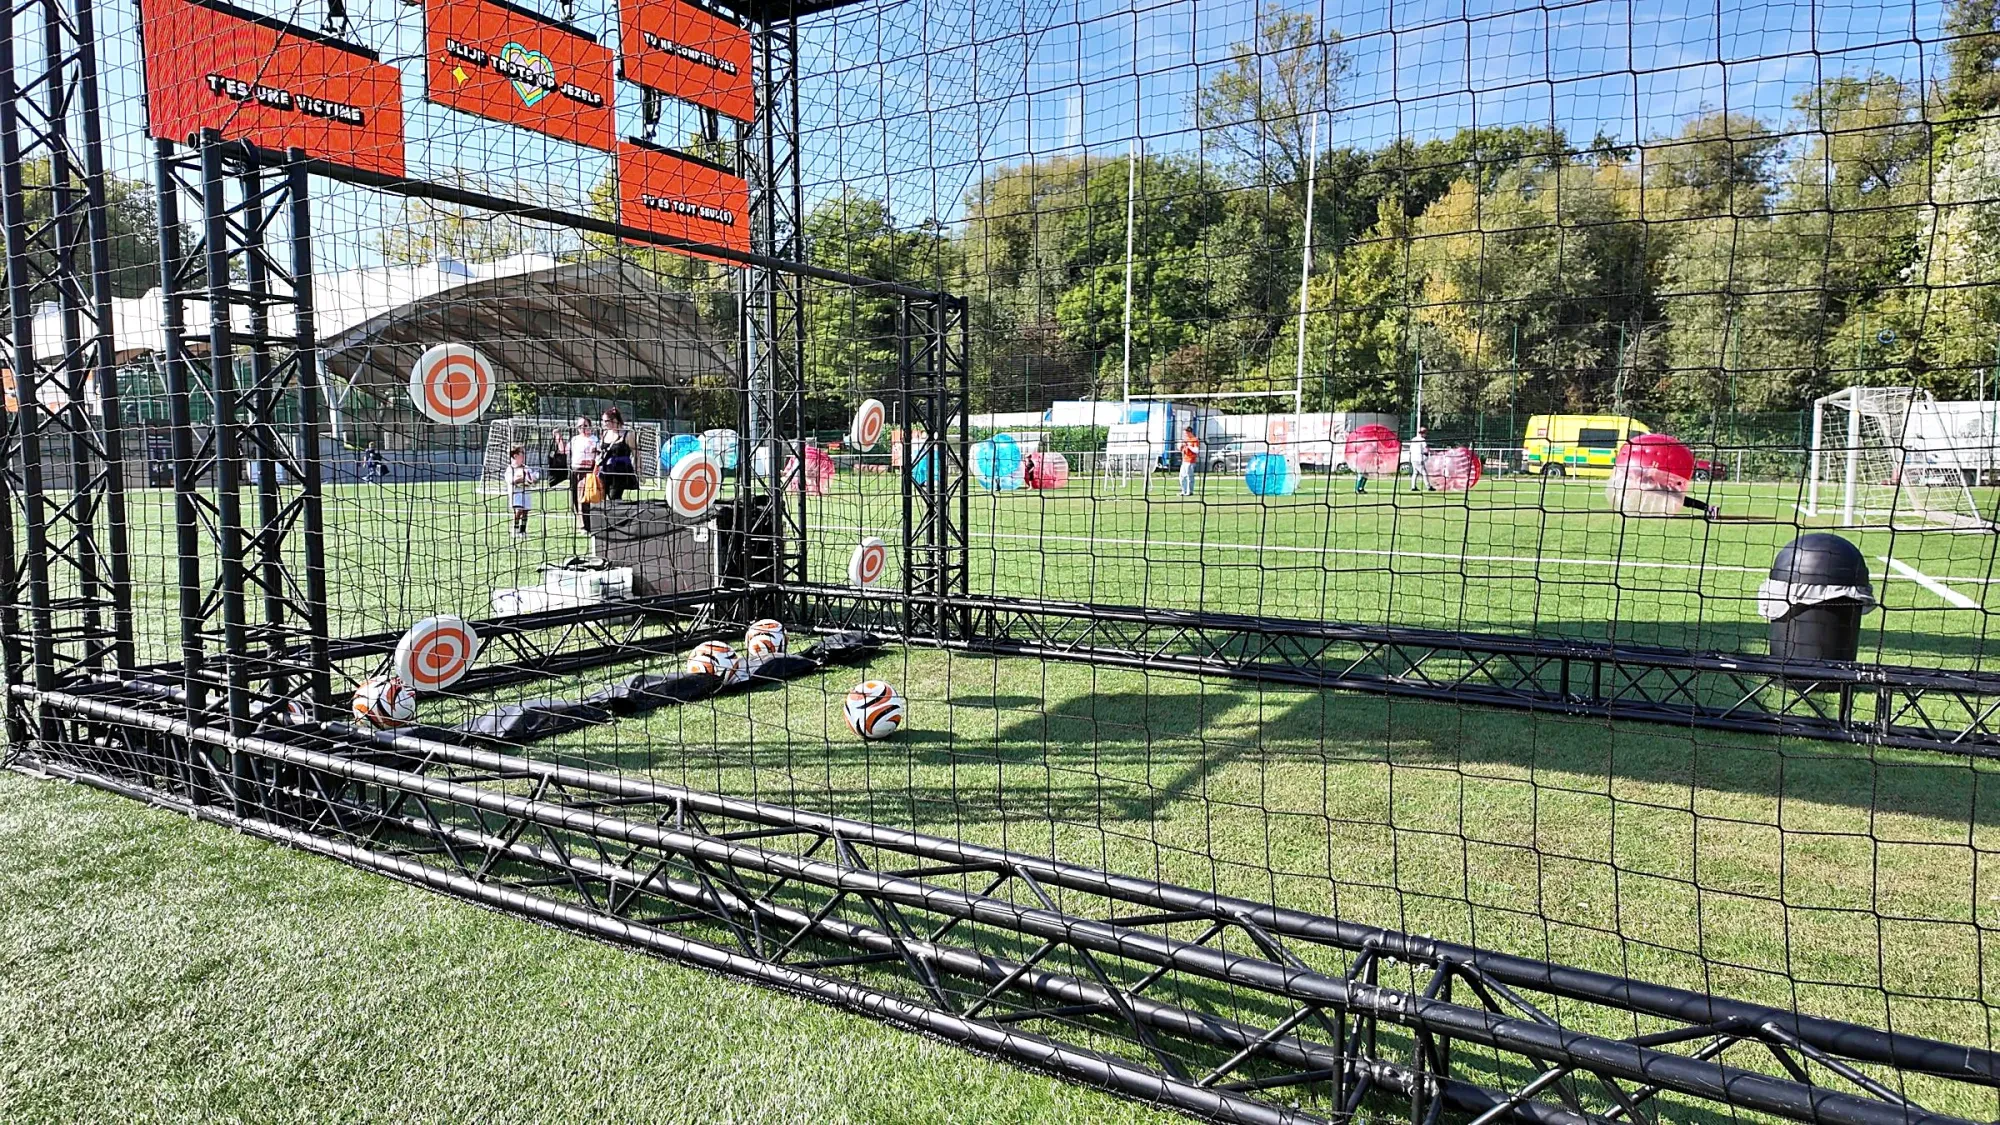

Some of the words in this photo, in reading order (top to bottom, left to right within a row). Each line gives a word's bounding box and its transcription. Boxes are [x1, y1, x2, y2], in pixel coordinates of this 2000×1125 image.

[643, 32, 658, 46] TU
[490, 55, 534, 79] TROTS
[537, 73, 556, 88] OP
[560, 82, 602, 104] JEZELF
[207, 74, 249, 97] T'ES
[256, 86, 290, 105] UNE
[295, 95, 361, 121] VICTIME
[641, 194, 656, 207] TU
[657, 198, 670, 209] ES
[672, 201, 697, 215] TOUT
